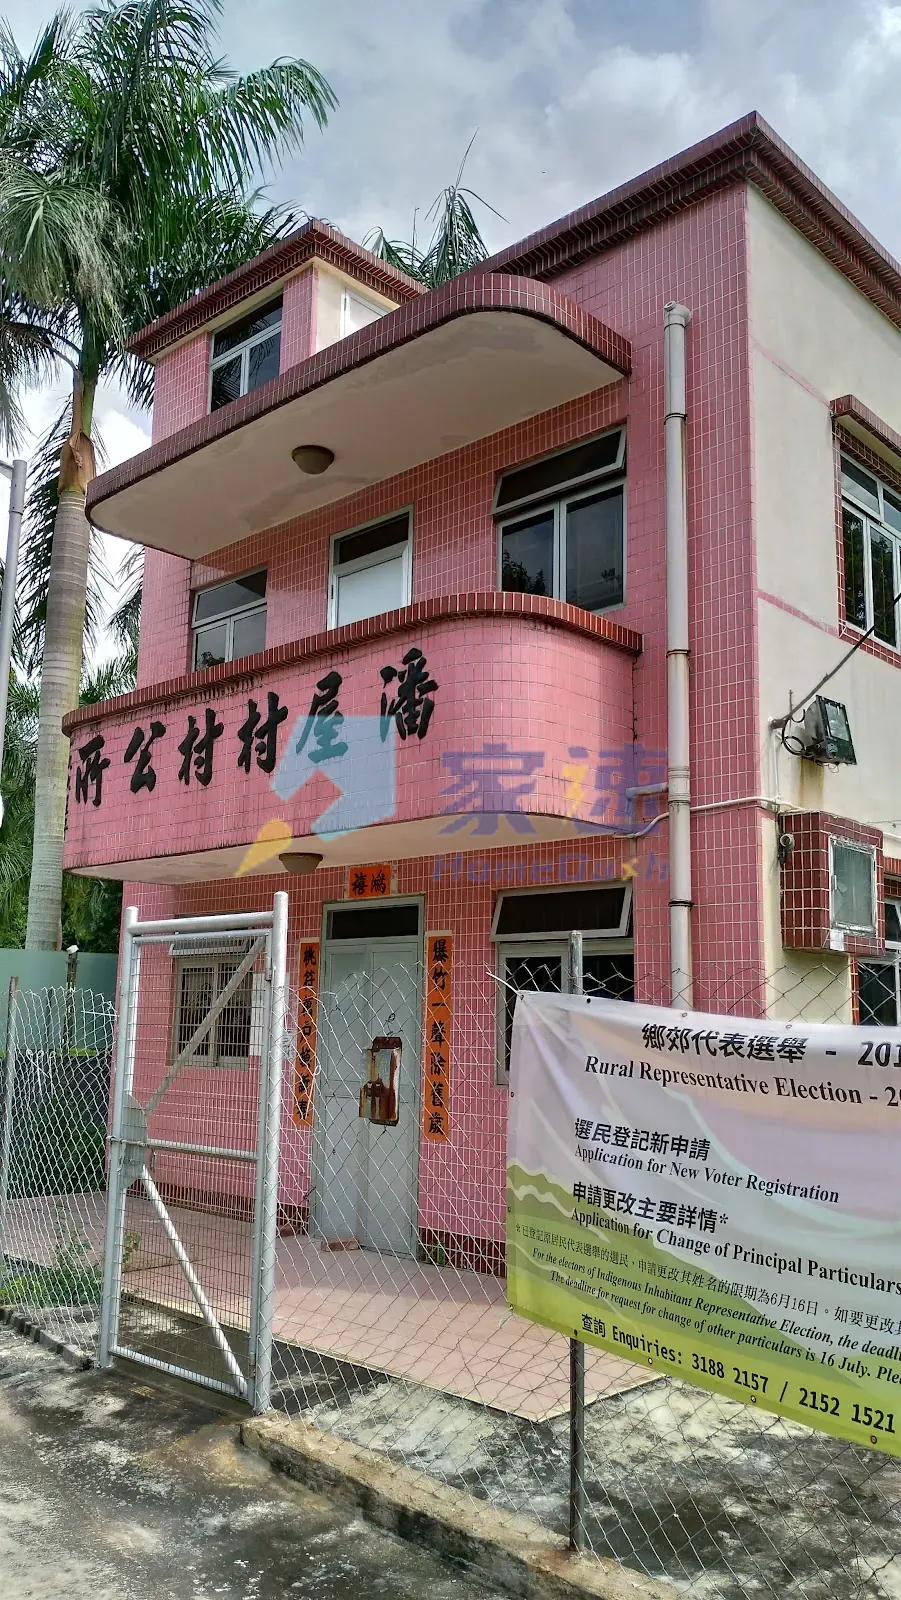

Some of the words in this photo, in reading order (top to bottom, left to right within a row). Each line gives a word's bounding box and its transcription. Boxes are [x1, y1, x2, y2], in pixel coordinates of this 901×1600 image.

[642, 1023, 808, 1063] 鄉郊代表選舉
[584, 1055, 634, 1079] Rural
[639, 1061, 770, 1095] Representative
[773, 1076, 863, 1105] Election
[884, 1086, 901, 1107] 2
[574, 1144, 643, 1170] Application
[646, 1158, 667, 1174] for
[669, 1161, 700, 1180] New
[704, 1167, 743, 1187] Voter
[745, 1173, 840, 1203] Registration
[575, 1117, 711, 1162] 選民登記新申請
[571, 1207, 630, 1235] Application
[633, 1222, 653, 1240] for
[656, 1228, 711, 1256] Change
[715, 1242, 731, 1258] of
[732, 1244, 802, 1274] Principal
[807, 1258, 901, 1296] Particulars
[532, 1247, 544, 1260] For
[546, 1253, 557, 1264] the
[558, 1255, 586, 1274] electors
[587, 1265, 597, 1279] of
[597, 1267, 642, 1292] Indigenous
[644, 1281, 693, 1307] Inhabitant
[694, 1296, 778, 1329] Representative
[779, 1318, 834, 1346] Election,
[837, 1334, 859, 1350] the
[550, 1270, 565, 1284] The
[565, 1275, 596, 1295] deadline
[596, 1287, 610, 1301] for
[610, 1292, 641, 1311] request
[641, 1301, 657, 1314] for
[657, 1307, 692, 1328] change
[694, 1319, 707, 1333] of
[707, 1323, 736, 1340] other
[736, 1331, 801, 1359] particulars
[805, 1347, 816, 1362] is
[819, 1351, 835, 1367] 16
[838, 1356, 871, 1378] July.
[875, 1365, 901, 1384] Ple
[581, 1314, 606, 1338] 查詢
[612, 1325, 682, 1364] Enquiries:
[691, 1353, 725, 1379] 3188
[732, 1367, 769, 1394] 2157
[779, 1381, 789, 1403] /
[798, 1387, 840, 1417] 2152
[851, 1404, 896, 1434] 1521
